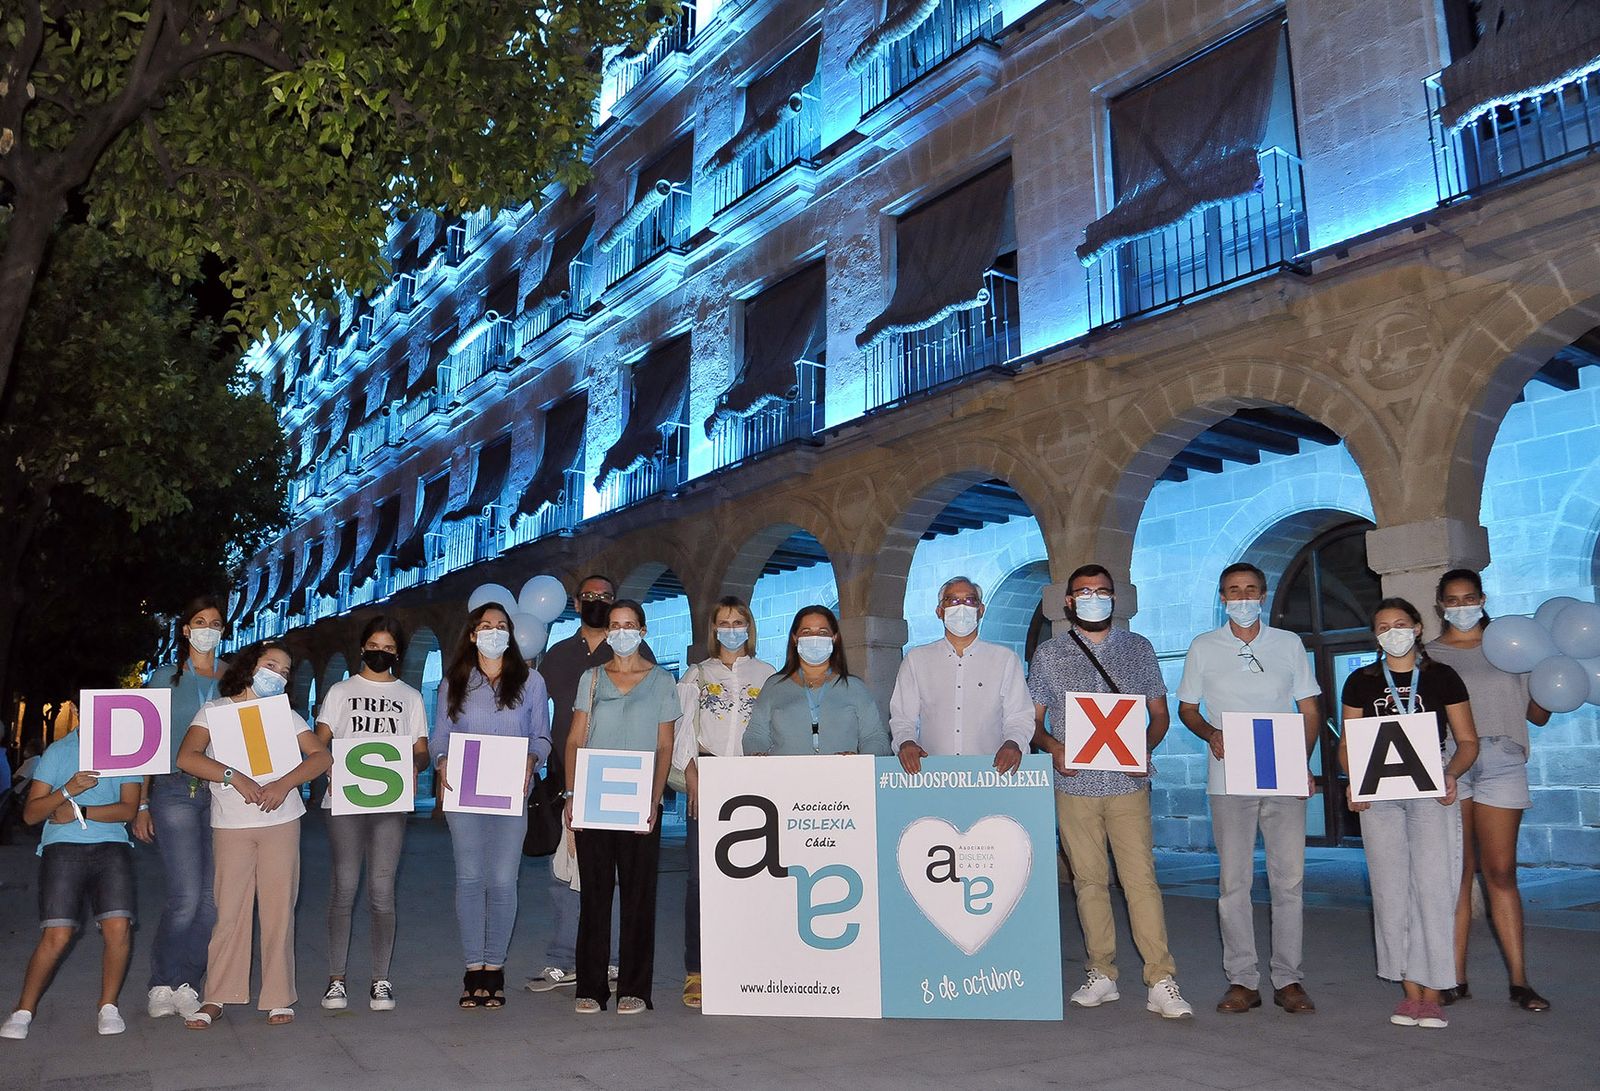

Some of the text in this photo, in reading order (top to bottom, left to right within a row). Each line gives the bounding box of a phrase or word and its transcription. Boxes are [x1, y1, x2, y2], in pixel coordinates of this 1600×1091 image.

[348, 695, 403, 713] TRÈS
[93, 694, 162, 770] D
[238, 705, 273, 776] I
[351, 716, 399, 734] BIEN
[1072, 697, 1140, 767] X
[1252, 719, 1277, 789] I
[1358, 721, 1438, 795] A
[342, 742, 404, 808] S
[458, 740, 512, 809] L
[584, 754, 642, 825] E
[879, 770, 1050, 789] #UNIDOSPORLADISLEXIA
[787, 818, 856, 830] DISLEXIA
[792, 801, 850, 811] Asociación
[805, 837, 836, 848] Cádiz
[959, 853, 994, 861] DISLEXIA
[740, 980, 840, 994] www.dislexiacadiz.es
[921, 967, 1024, 1004] 8 de octubre
